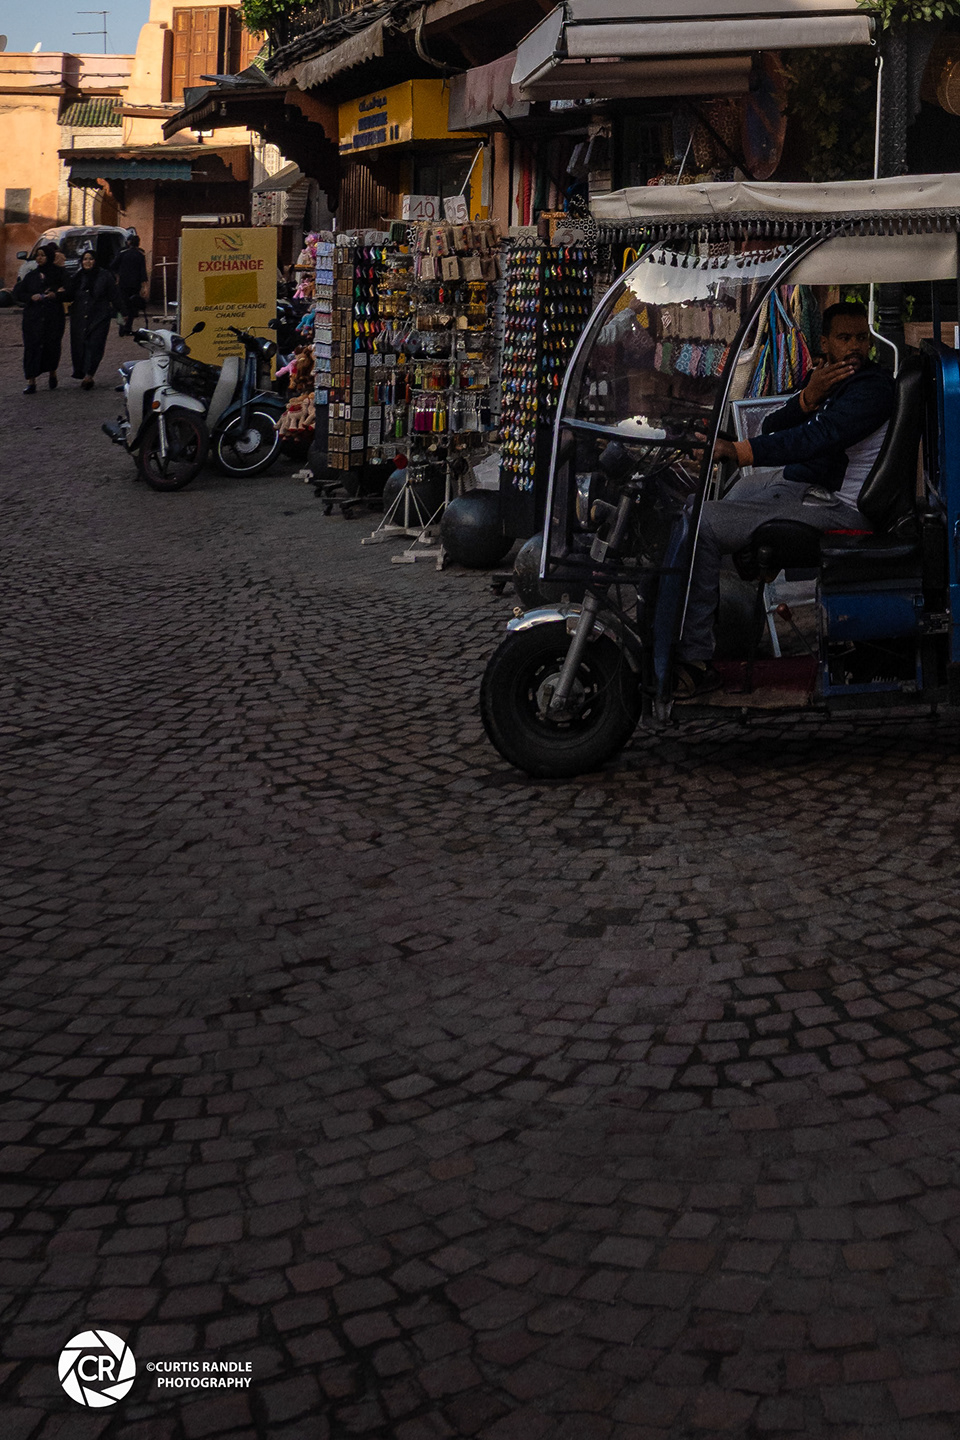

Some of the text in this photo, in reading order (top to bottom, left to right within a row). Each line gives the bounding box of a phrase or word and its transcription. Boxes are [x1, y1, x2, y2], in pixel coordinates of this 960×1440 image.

[198, 259, 264, 272] EXCHANGE
[194, 304, 224, 312] BUREAU
[237, 302, 267, 310] CHANGE
[215, 311, 246, 319] CHANGE
